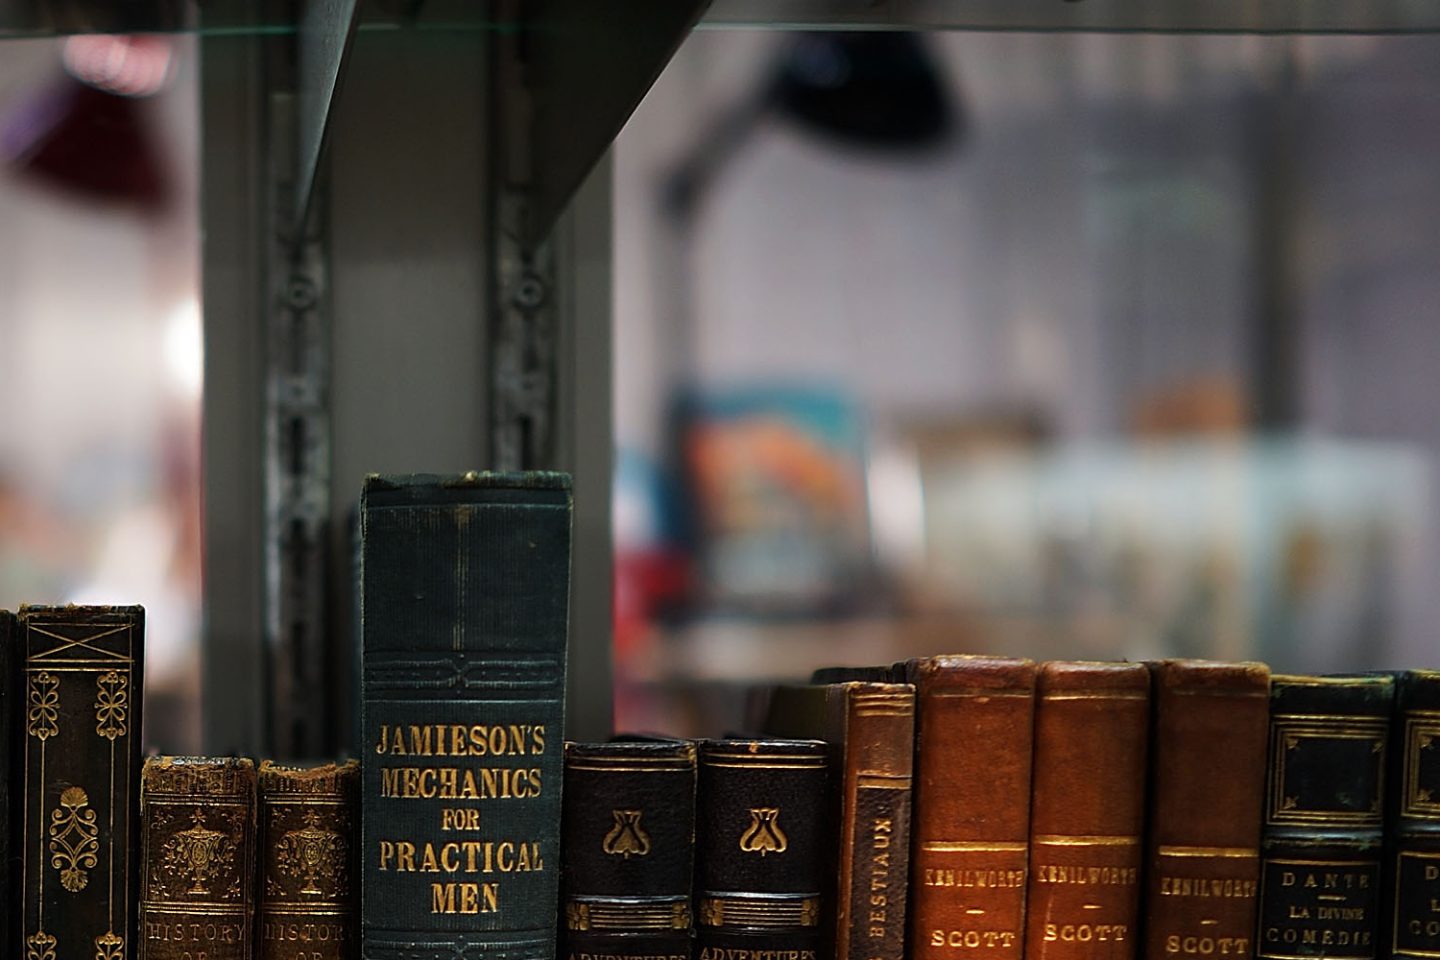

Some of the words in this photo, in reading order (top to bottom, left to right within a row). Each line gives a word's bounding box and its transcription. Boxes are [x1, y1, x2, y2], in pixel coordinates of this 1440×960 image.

[376, 724, 545, 756] JAMIESON'S
[380, 768, 542, 799] MECHANICS
[441, 808, 480, 830] FOR
[379, 841, 544, 873] PRACTICAL
[870, 818, 894, 938] BESTIAUX
[924, 868, 1024, 888] KENILWORTH
[1037, 865, 1137, 885] KENILWORTH
[1281, 872, 1370, 889] DANTE
[431, 883, 500, 914] MEN
[1290, 906, 1311, 918] LA
[1318, 906, 1365, 920] DIVINE
[146, 922, 246, 942] HISTORY
[931, 930, 1016, 947] SCOTT
[1043, 924, 1127, 941] SCOTT
[1166, 935, 1249, 954] SCOTT
